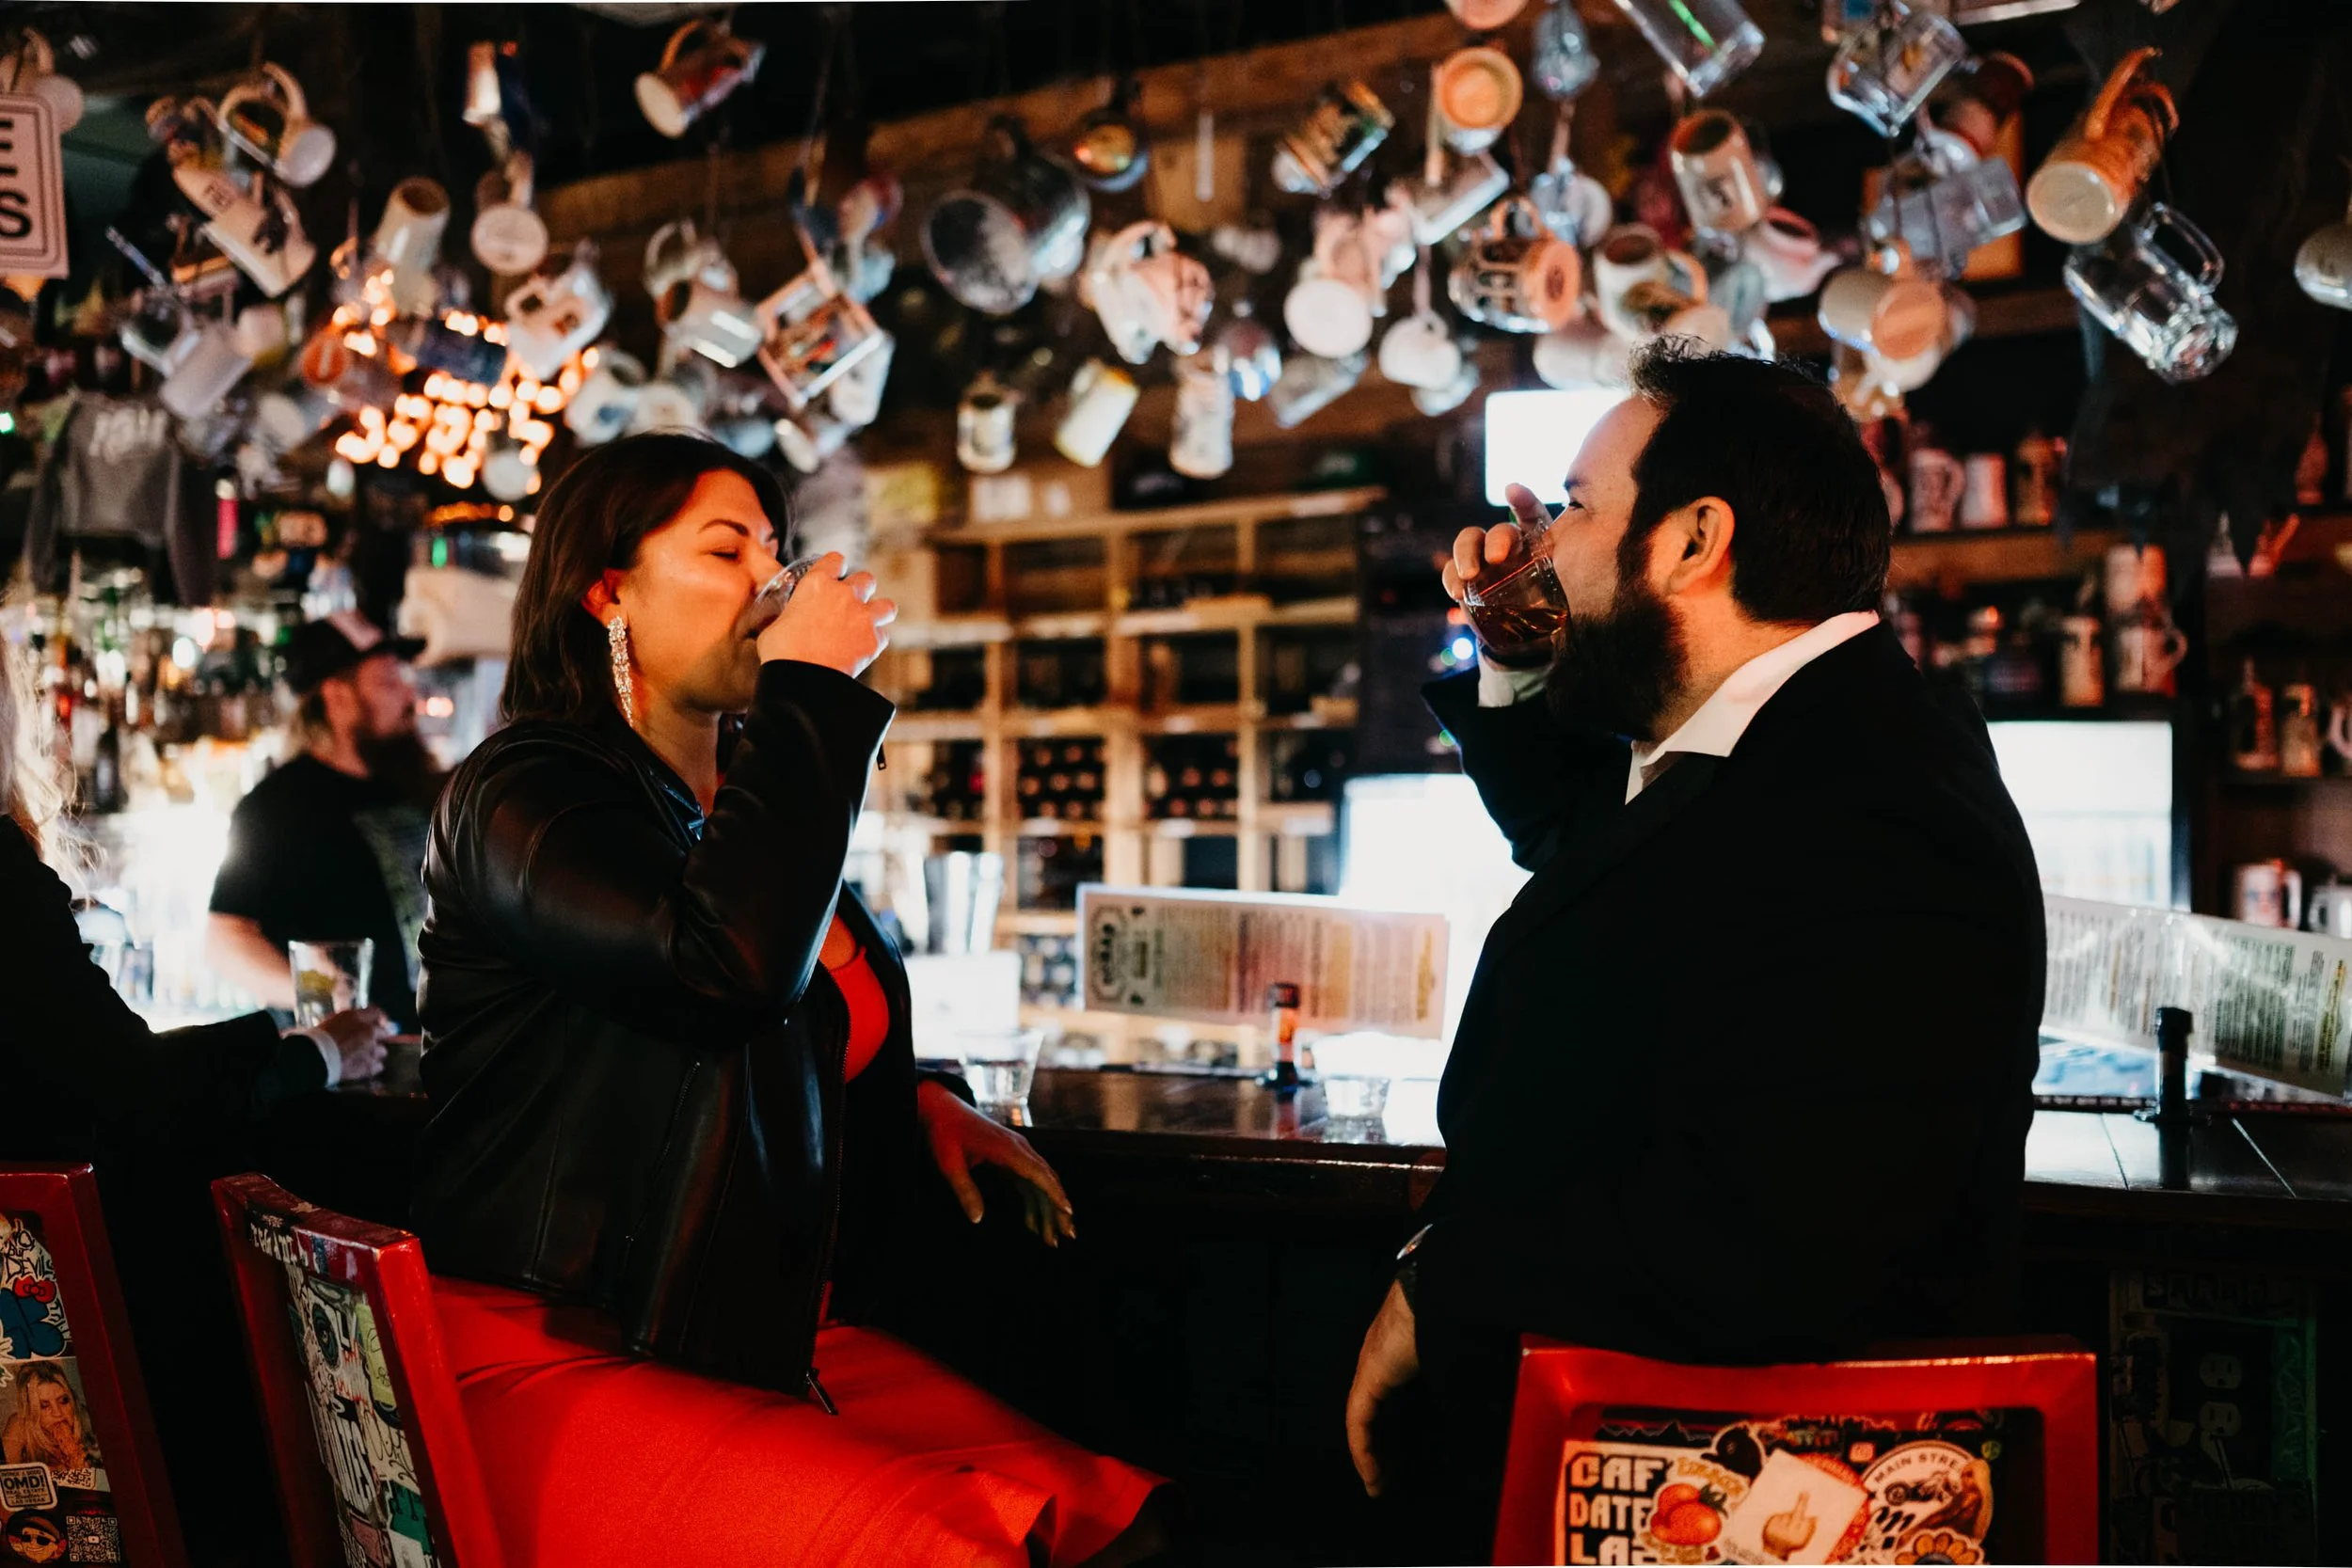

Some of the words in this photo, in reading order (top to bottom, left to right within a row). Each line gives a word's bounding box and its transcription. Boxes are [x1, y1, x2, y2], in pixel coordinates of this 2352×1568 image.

[4, 1475, 45, 1489] OMD!
[1570, 1454, 1665, 1492] CAF
[1875, 1457, 1912, 1483] MAIN
[1919, 1451, 1959, 1469] STRE
